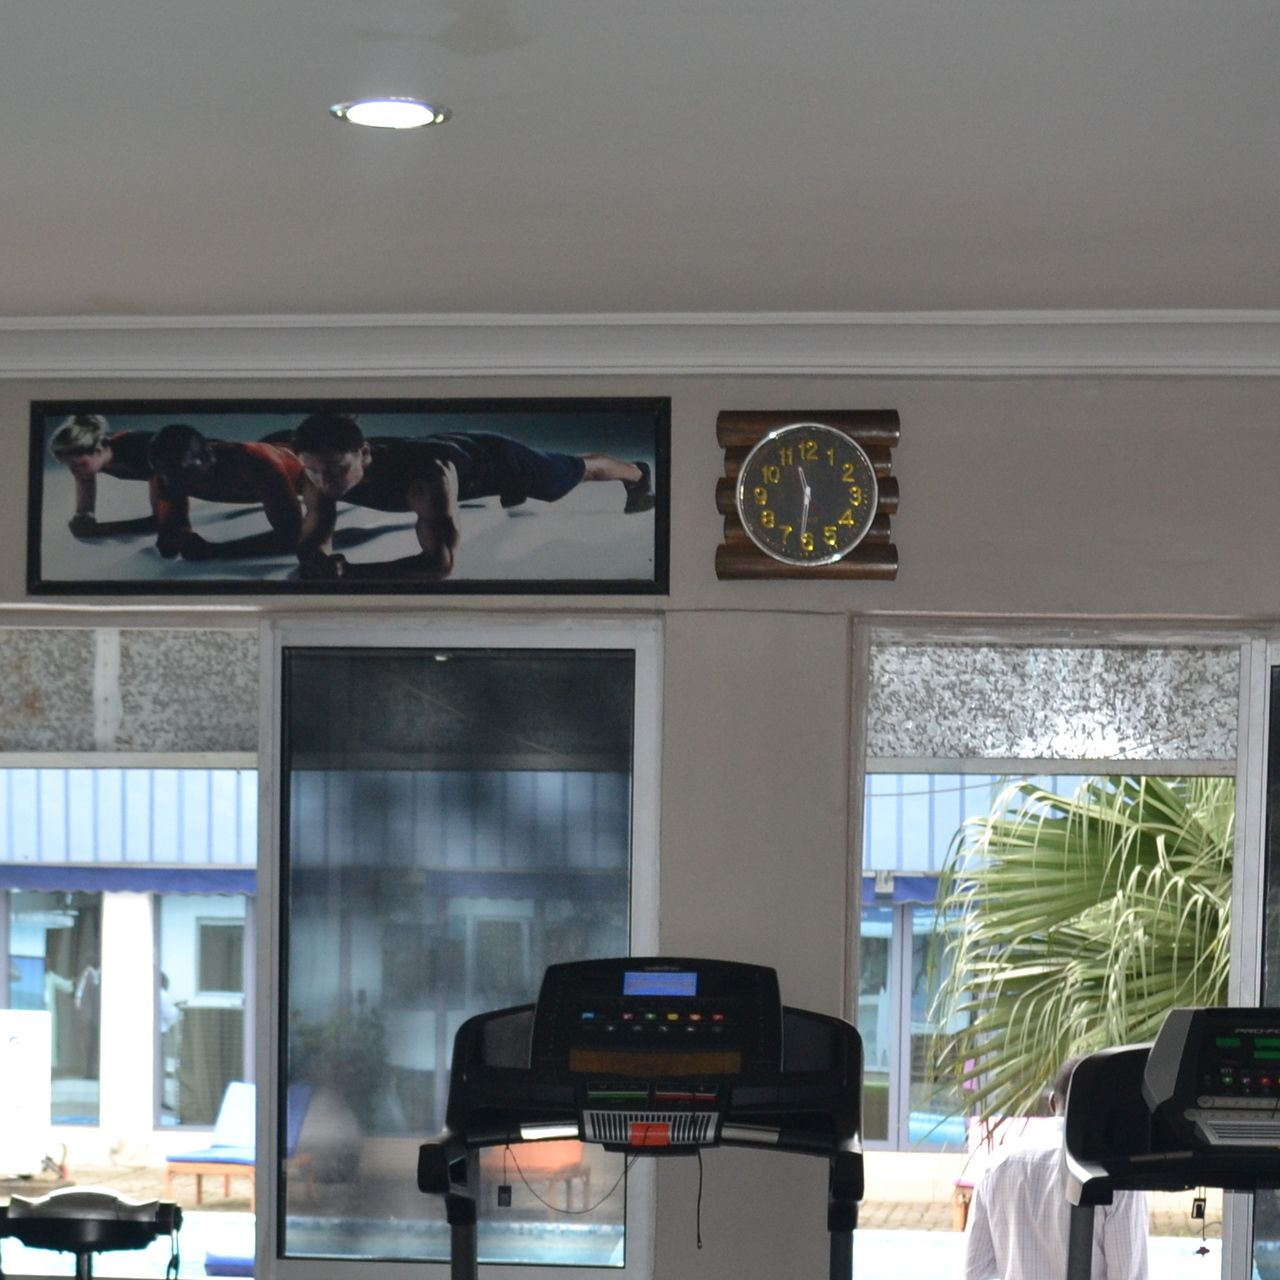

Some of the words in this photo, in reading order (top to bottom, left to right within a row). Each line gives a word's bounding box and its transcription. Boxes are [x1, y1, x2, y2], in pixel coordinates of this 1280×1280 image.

[780, 448, 793, 466] 11
[798, 440, 819, 460] 12
[826, 448, 834, 466] 1
[762, 465, 781, 484] 10
[841, 463, 855, 482] 2
[753, 486, 768, 505] 9
[848, 486, 862, 506] 3
[761, 510, 775, 528] 8
[838, 509, 854, 528] 4
[779, 525, 793, 544] 7
[800, 532, 814, 551] 6
[823, 526, 837, 545] 5
